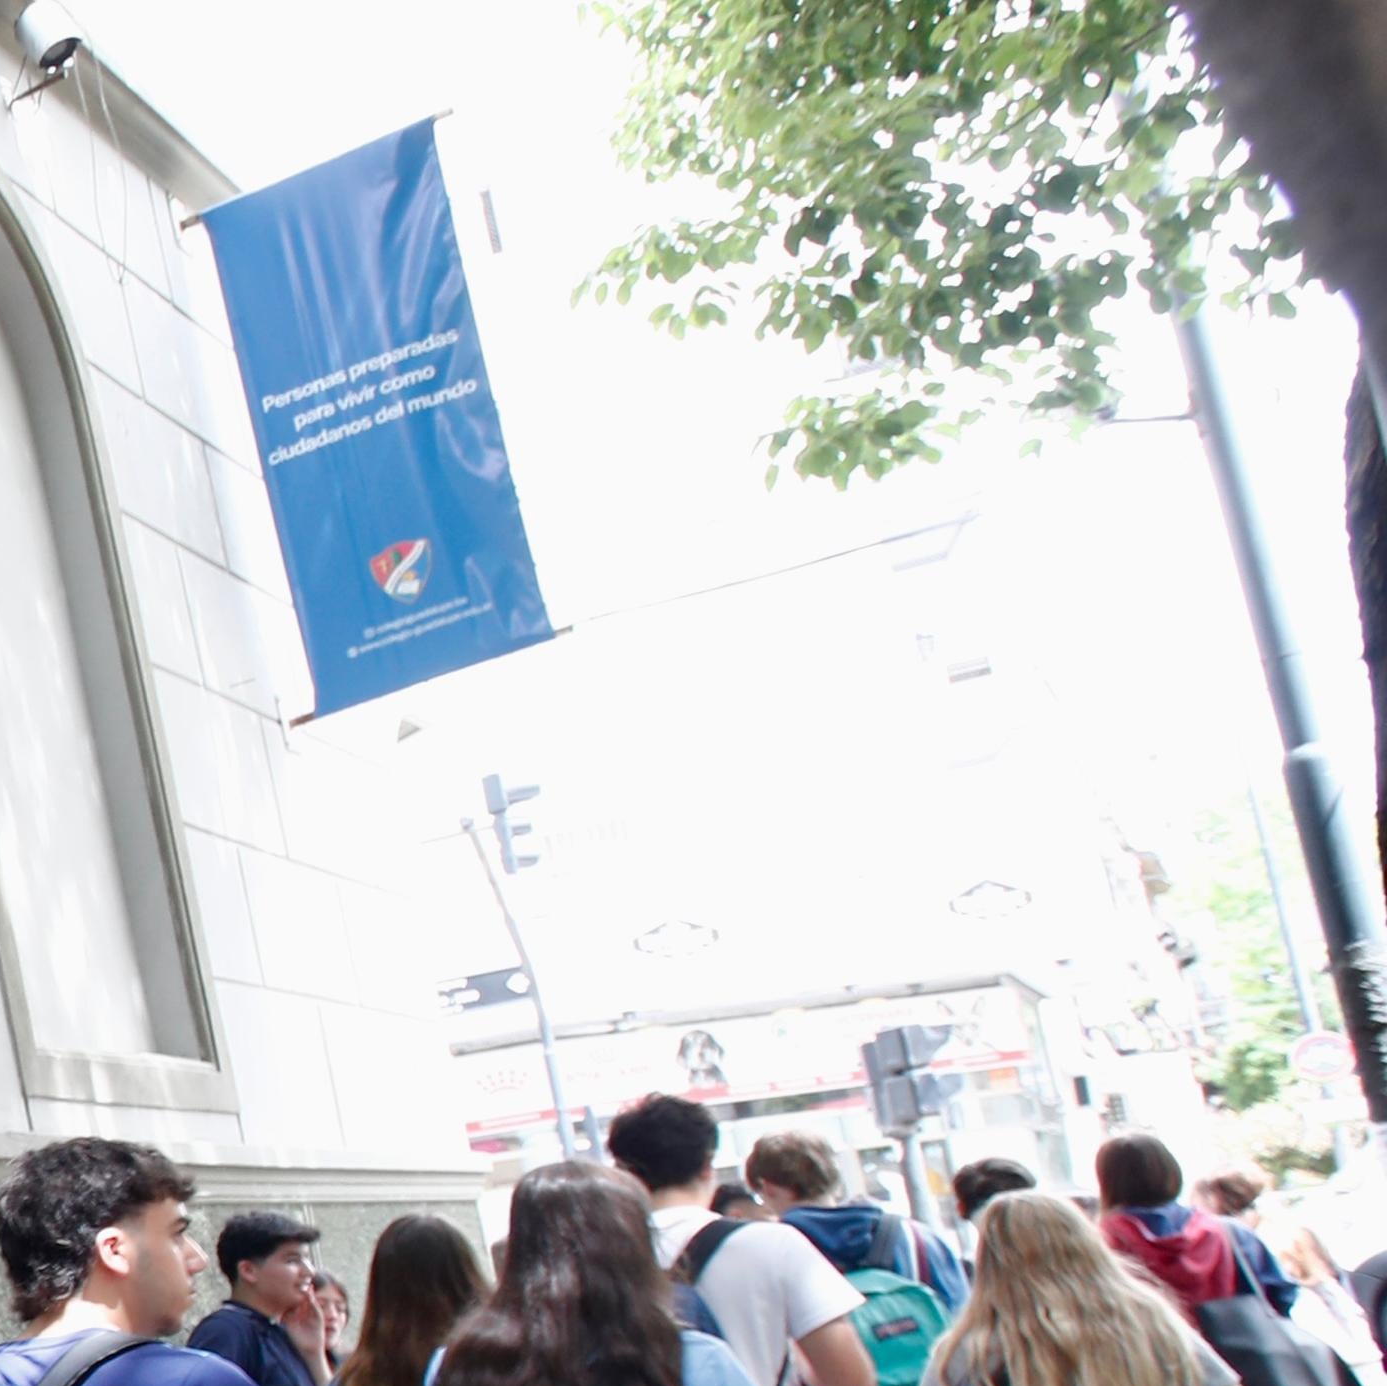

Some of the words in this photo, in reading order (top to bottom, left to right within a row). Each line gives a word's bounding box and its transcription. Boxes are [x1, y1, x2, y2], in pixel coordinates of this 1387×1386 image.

[262, 368, 347, 413] Personas
[348, 328, 459, 383] preparadas
[293, 402, 336, 432] para
[337, 384, 376, 411] vivir
[379, 364, 436, 395] como
[268, 415, 372, 466] ciudadanos
[375, 401, 405, 425] del
[407, 378, 477, 414] mundo
